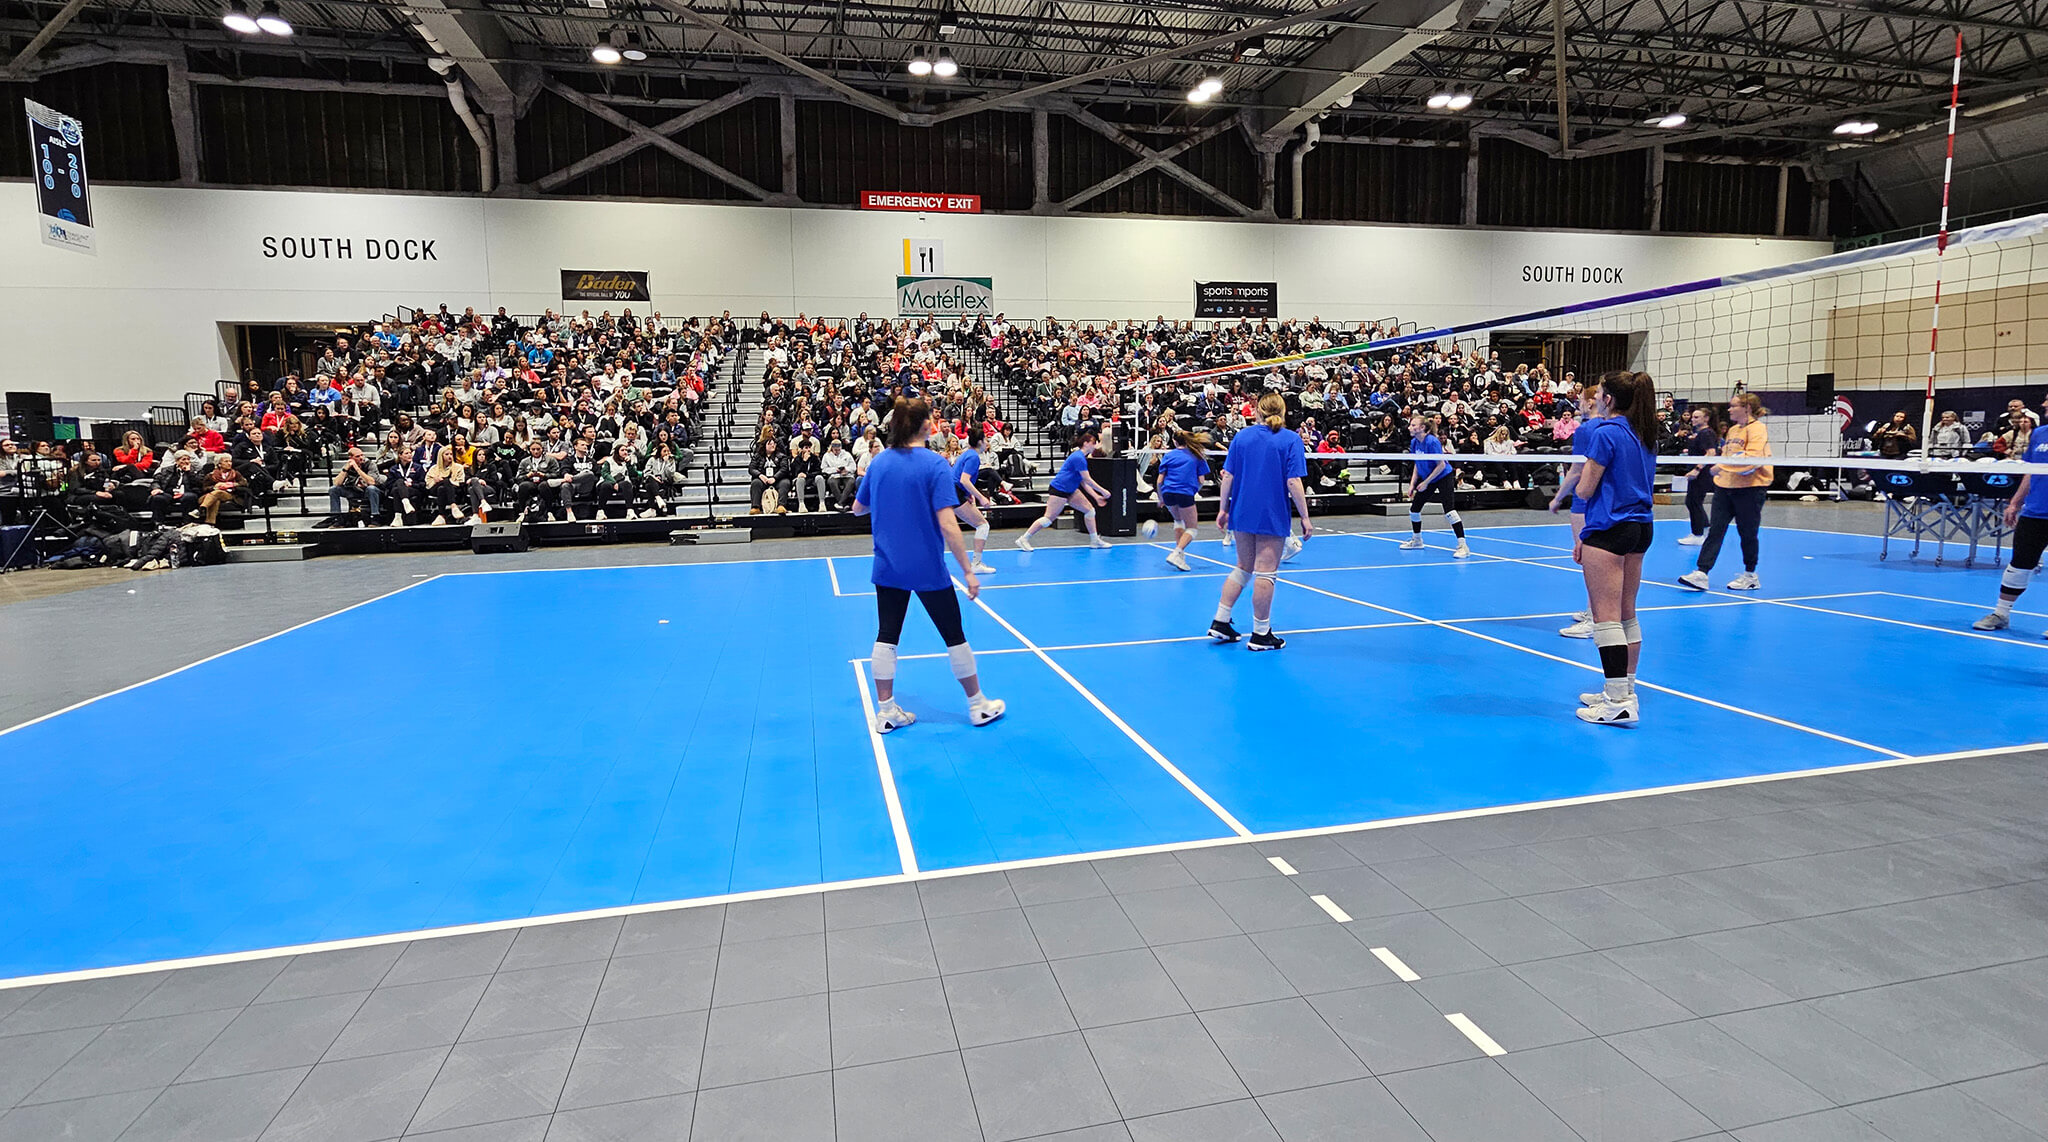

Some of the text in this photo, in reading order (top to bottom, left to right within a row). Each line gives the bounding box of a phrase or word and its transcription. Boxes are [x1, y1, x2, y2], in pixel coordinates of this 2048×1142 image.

[49, 136, 67, 148] AISLE
[868, 195, 973, 209] EMERGENCY EXIT
[262, 236, 438, 261] SOUTH DOCK
[576, 274, 636, 290] Baden
[1522, 265, 1623, 284] SOUTH DOCK
[614, 290, 631, 300] YOU
[902, 285, 988, 309] Matéflex
[1203, 286, 1233, 298] sports
